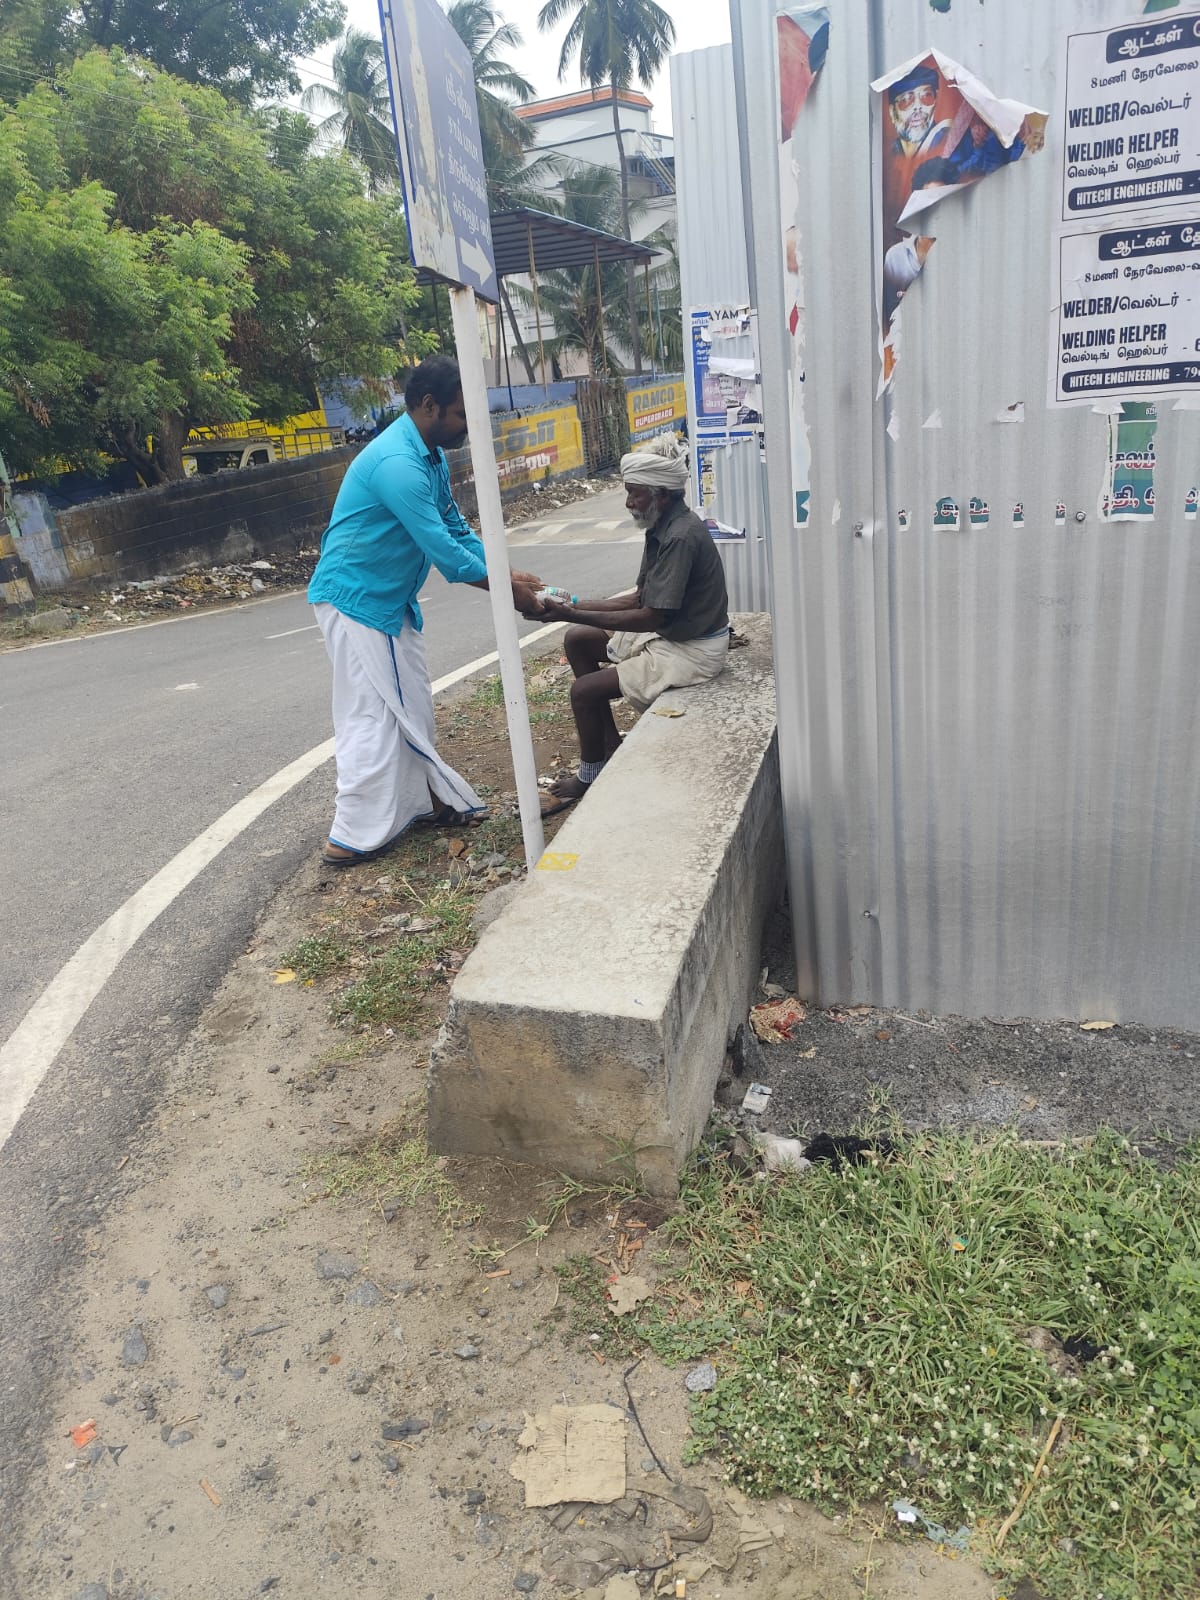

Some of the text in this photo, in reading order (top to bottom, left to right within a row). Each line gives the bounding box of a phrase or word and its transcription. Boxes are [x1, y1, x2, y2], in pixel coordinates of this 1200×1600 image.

[1118, 25, 1183, 56] ஆட்கள்
[1068, 128, 1179, 163] WELDING HELPER
[1076, 178, 1183, 206] HITECH ENGINEERING
[1111, 230, 1171, 256] ஆட்கள்
[1062, 323, 1167, 350] WELDING HELPER
[1070, 373, 1102, 388] HITECH
[1104, 367, 1170, 385] ENGINEERING
[633, 386, 674, 413] RAMCO
